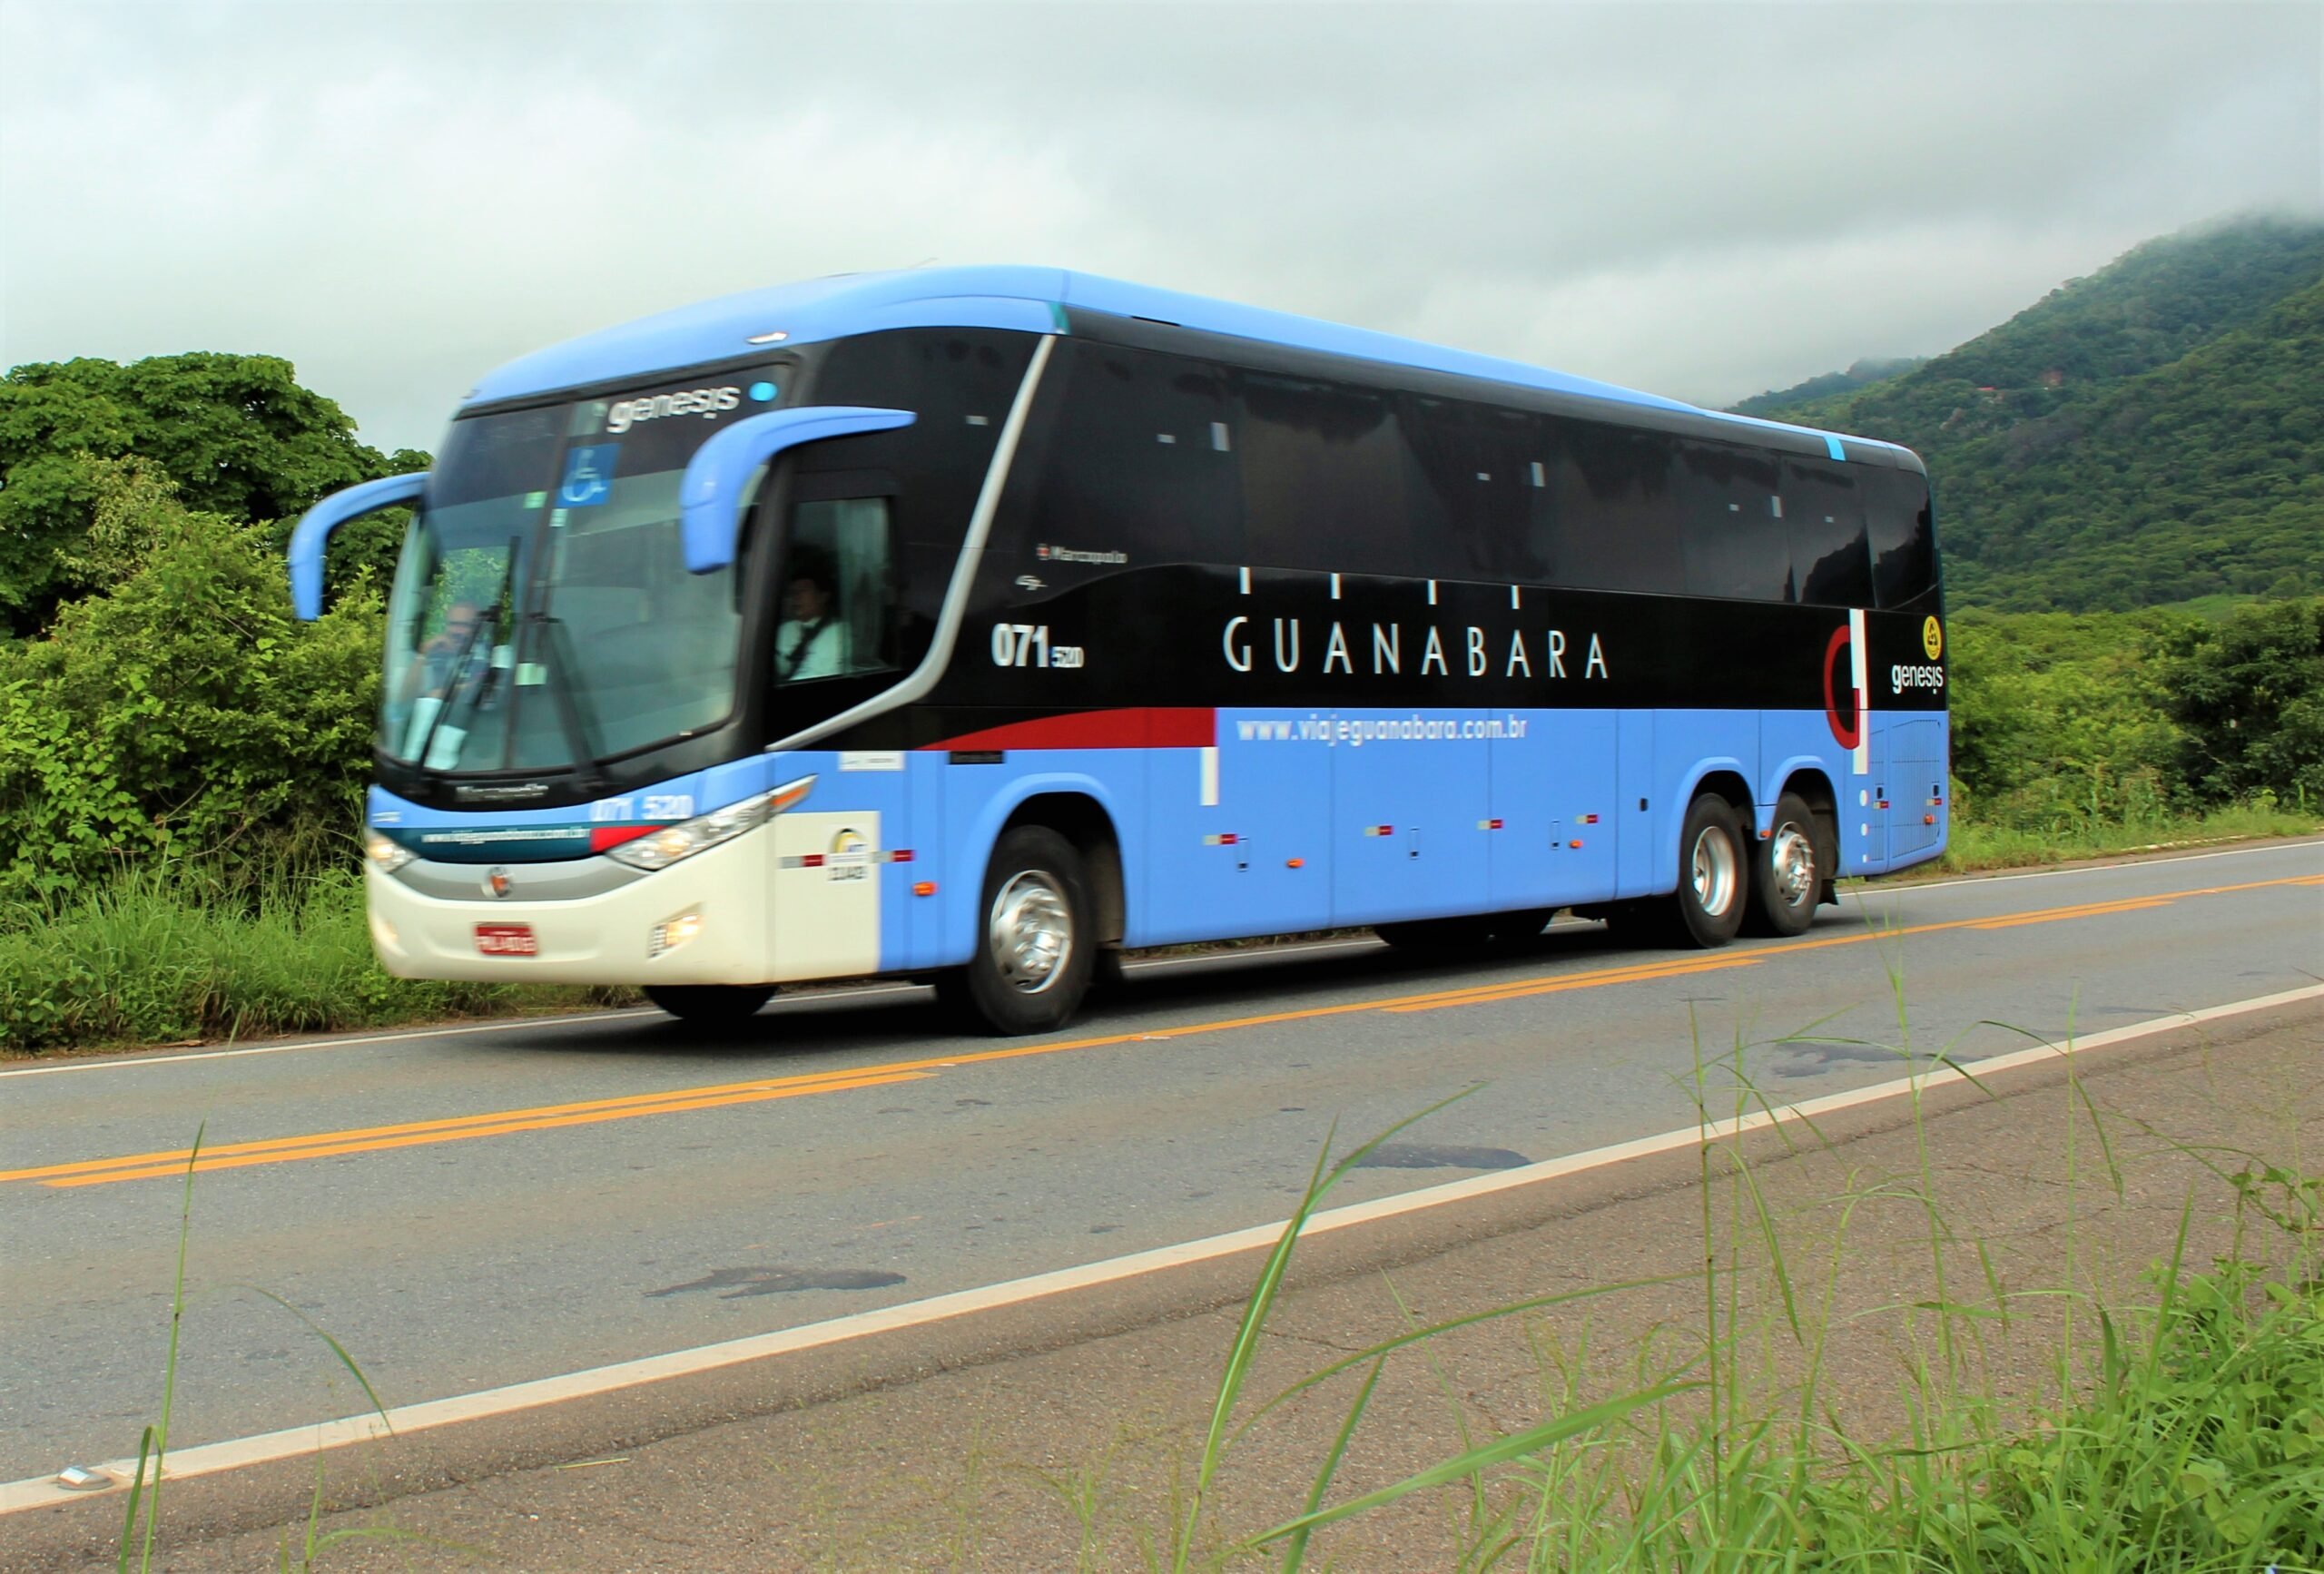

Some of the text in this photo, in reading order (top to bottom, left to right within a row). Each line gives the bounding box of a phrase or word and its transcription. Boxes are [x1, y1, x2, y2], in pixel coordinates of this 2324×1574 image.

[606, 386, 741, 434] genesis
[991, 623, 1049, 667] 071
[1223, 616, 1609, 679] GUANABARA
[1891, 664, 1944, 694] genesis
[1236, 713, 1528, 746] www.viajeguanabara.com.br
